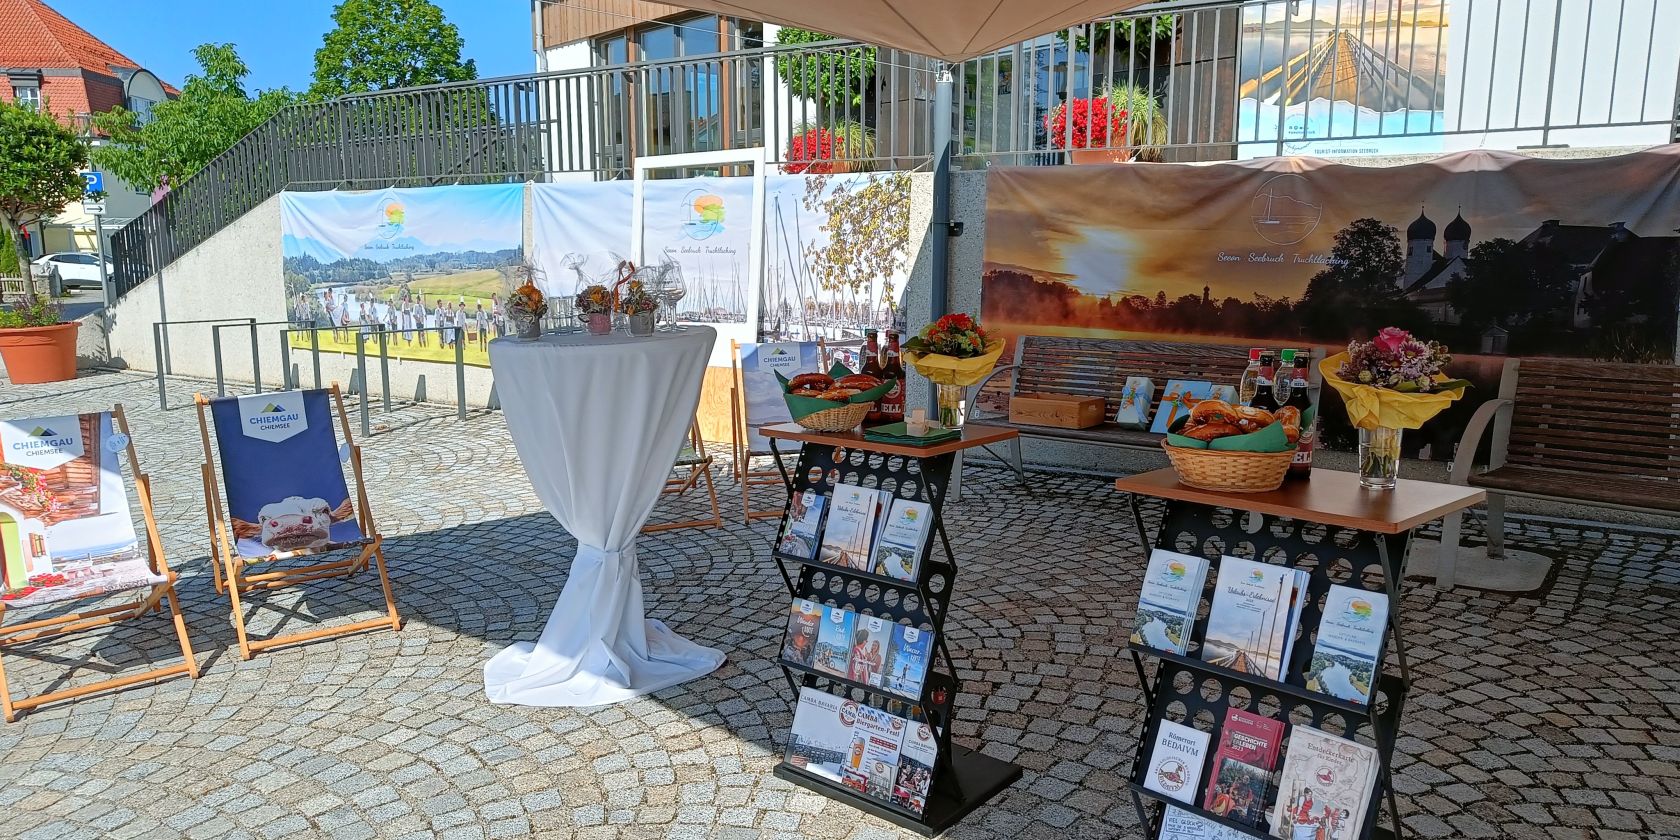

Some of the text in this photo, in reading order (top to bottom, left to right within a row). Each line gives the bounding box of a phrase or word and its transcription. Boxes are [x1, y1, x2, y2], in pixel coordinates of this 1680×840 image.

[85, 174, 98, 190] P
[1217, 251, 1350, 268] Seeon Seebruck Truchtlaching
[763, 355, 796, 363] CHIEMGAU
[249, 413, 299, 425] CHIEMGAU
[260, 422, 291, 431] CHIEMSEE
[12, 437, 73, 450] CHIEMGAU
[26, 448, 64, 457] CHIEMSEE
[857, 711, 878, 723] CAMBA
[1168, 731, 1196, 746] Römerort
[1232, 739, 1257, 751] ERLEBEN
[1234, 733, 1268, 749] GESCHICHTE
[1161, 738, 1199, 757] BEDAIVM
[1307, 742, 1354, 763] Entdeckerkarte
